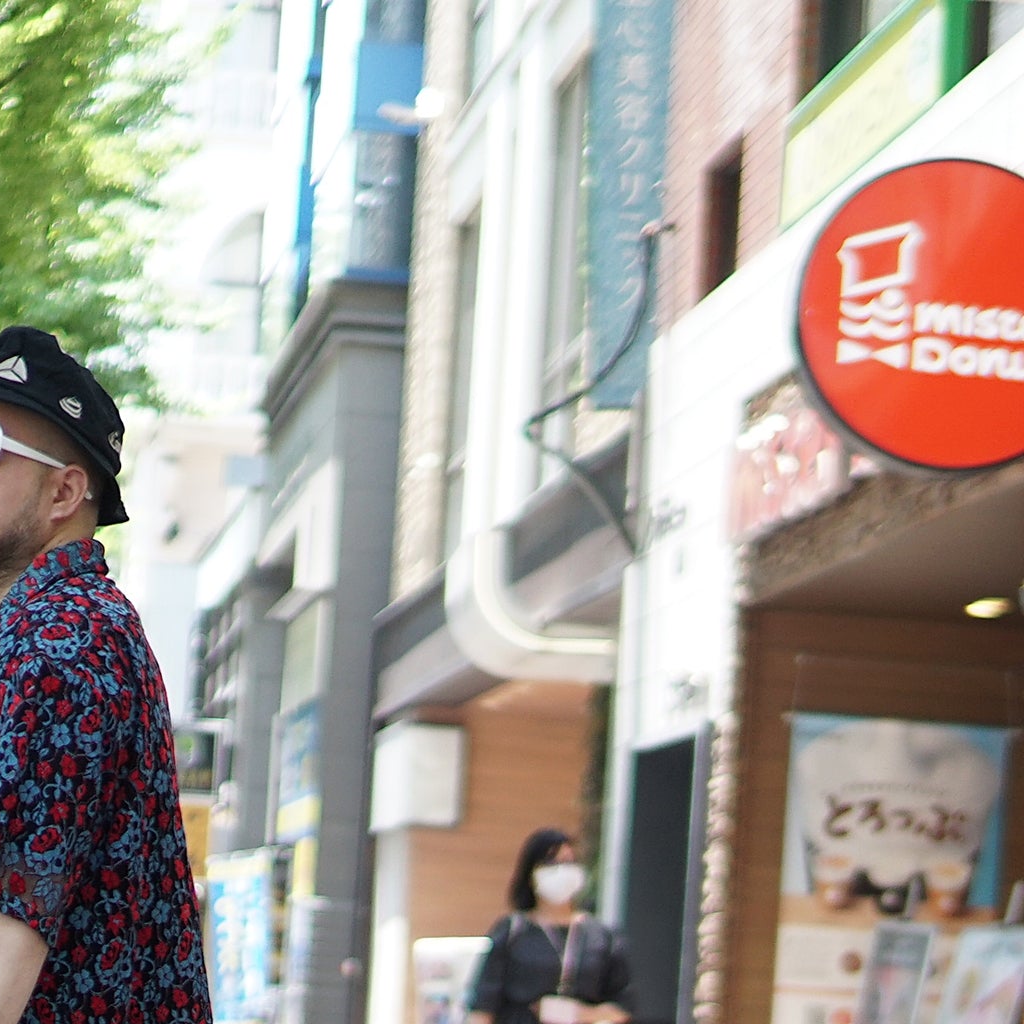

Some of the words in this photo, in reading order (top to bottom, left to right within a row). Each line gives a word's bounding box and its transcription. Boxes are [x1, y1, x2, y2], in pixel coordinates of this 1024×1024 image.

[613, 0, 658, 311] 心美容クリニック
